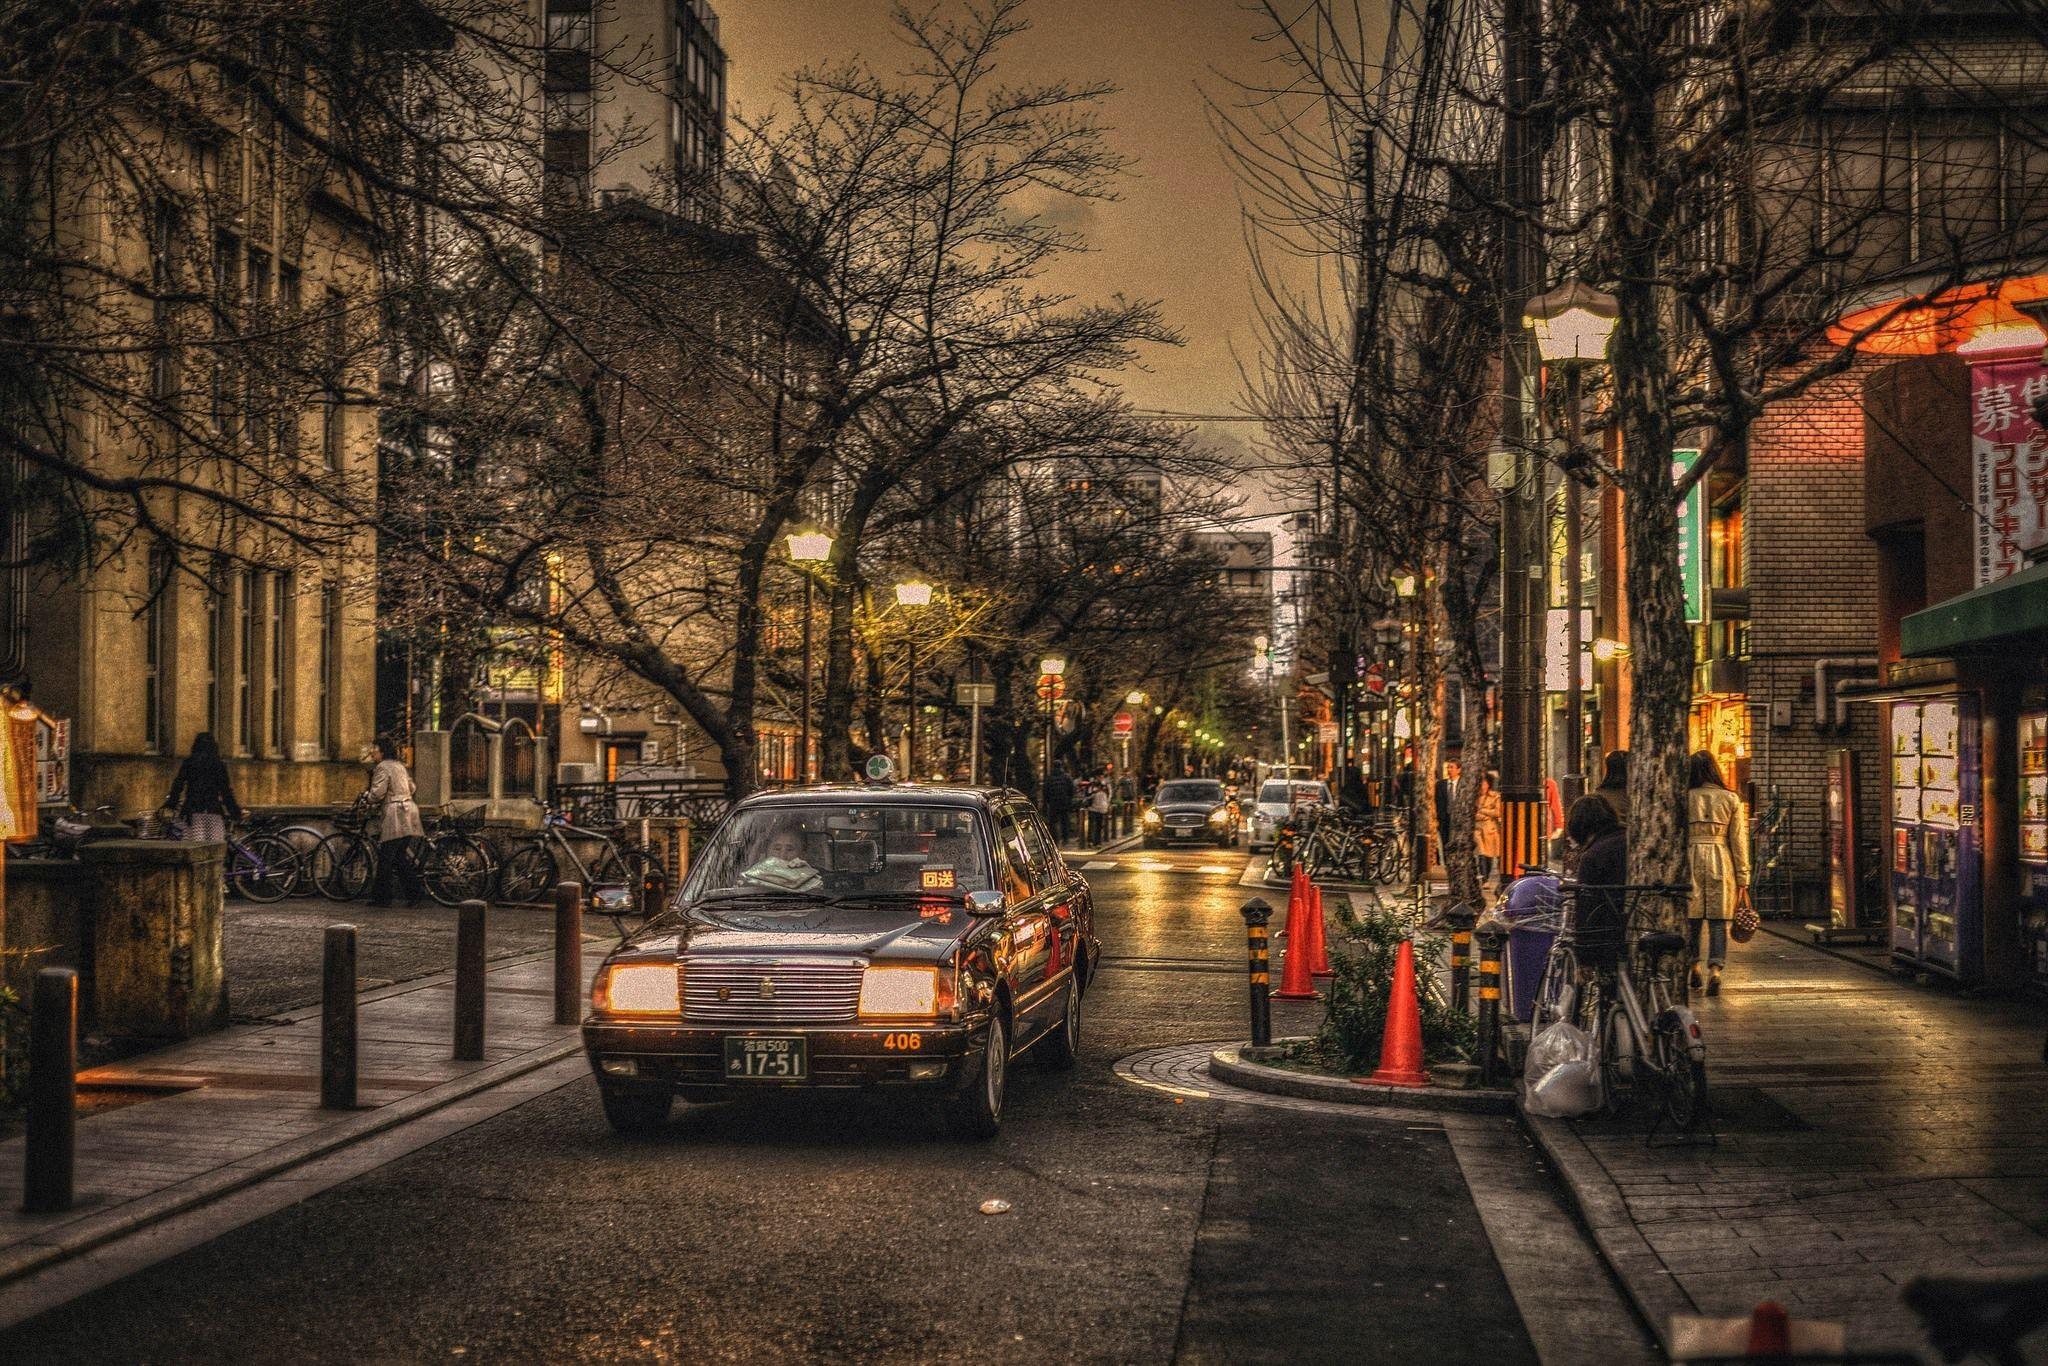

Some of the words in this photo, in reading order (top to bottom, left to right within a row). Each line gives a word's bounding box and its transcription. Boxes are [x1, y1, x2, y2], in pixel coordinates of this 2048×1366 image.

[923, 870, 954, 888] 回送
[884, 1032, 921, 1051] 406
[746, 1053, 800, 1075] 17-51
